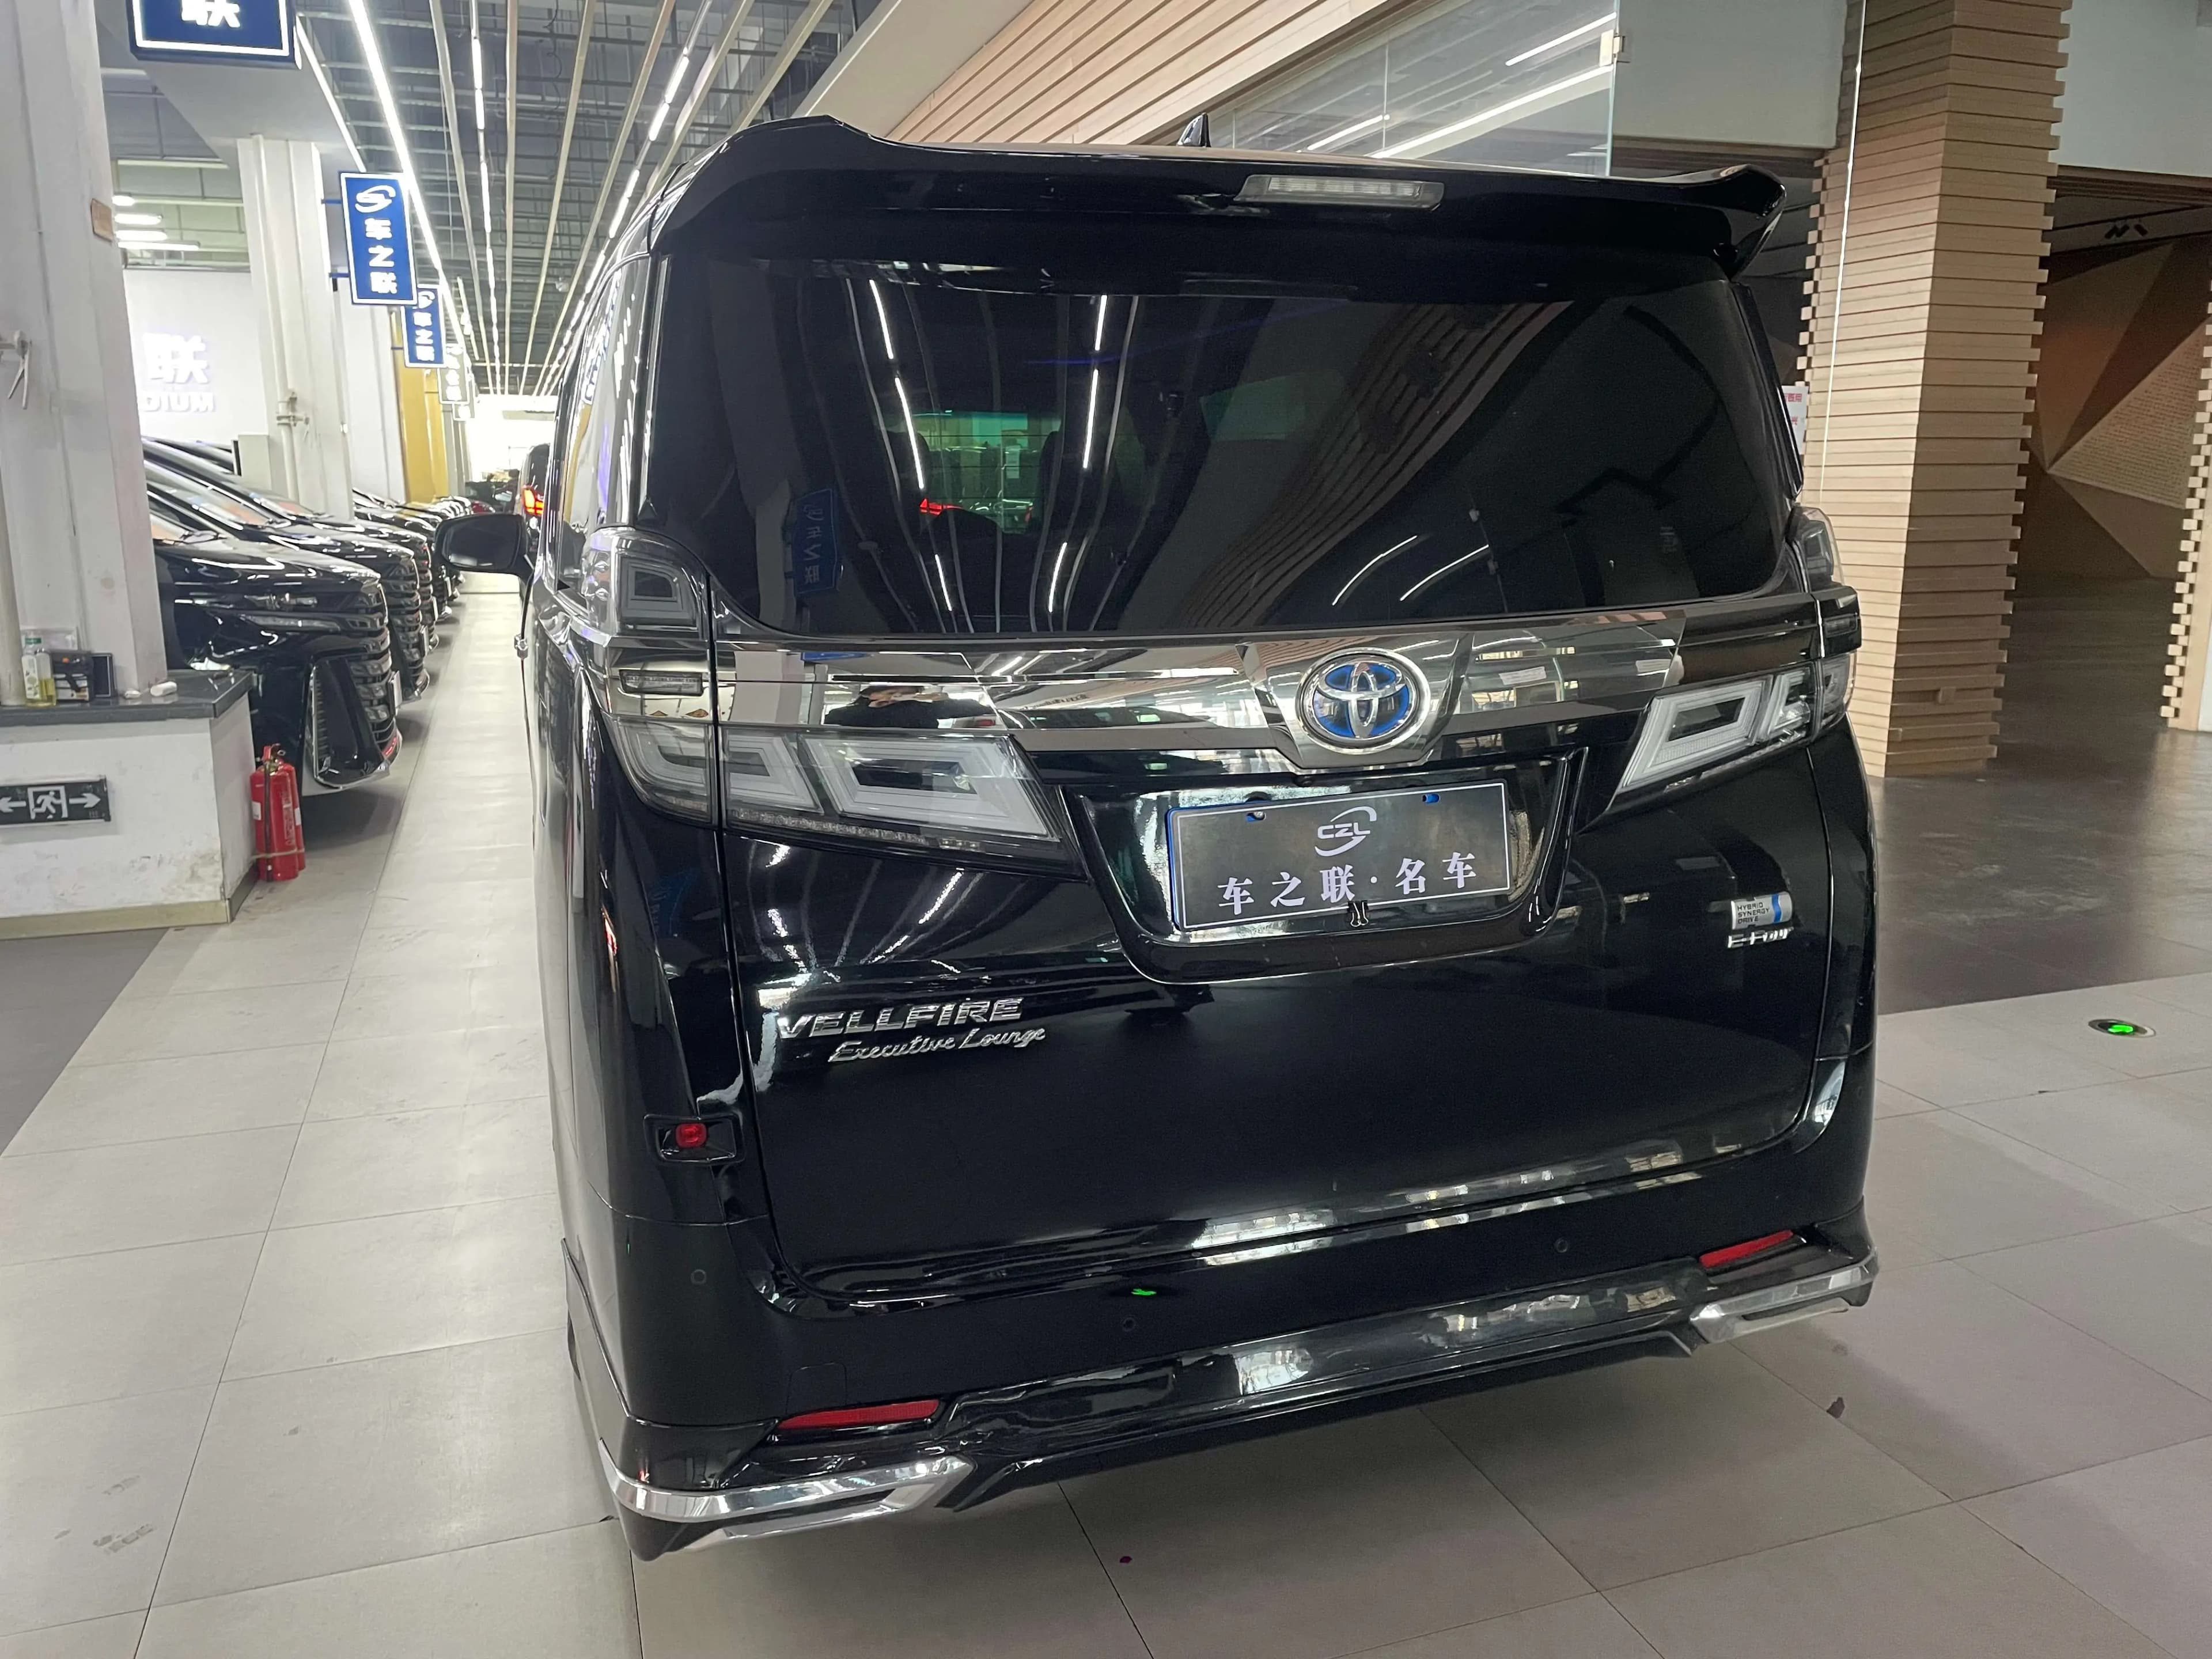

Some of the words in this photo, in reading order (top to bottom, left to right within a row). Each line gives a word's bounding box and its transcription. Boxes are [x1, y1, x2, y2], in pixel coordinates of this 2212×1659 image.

[1317, 823, 1370, 839] CZL
[1737, 902, 1763, 911] HYBRID
[1738, 908, 1770, 918] SYNERGY
[1737, 916, 1759, 924] DRIVE
[777, 998, 1023, 1039] VELLFIRE
[828, 1036, 956, 1062] Executive
[958, 1028, 1046, 1050] Lounge
